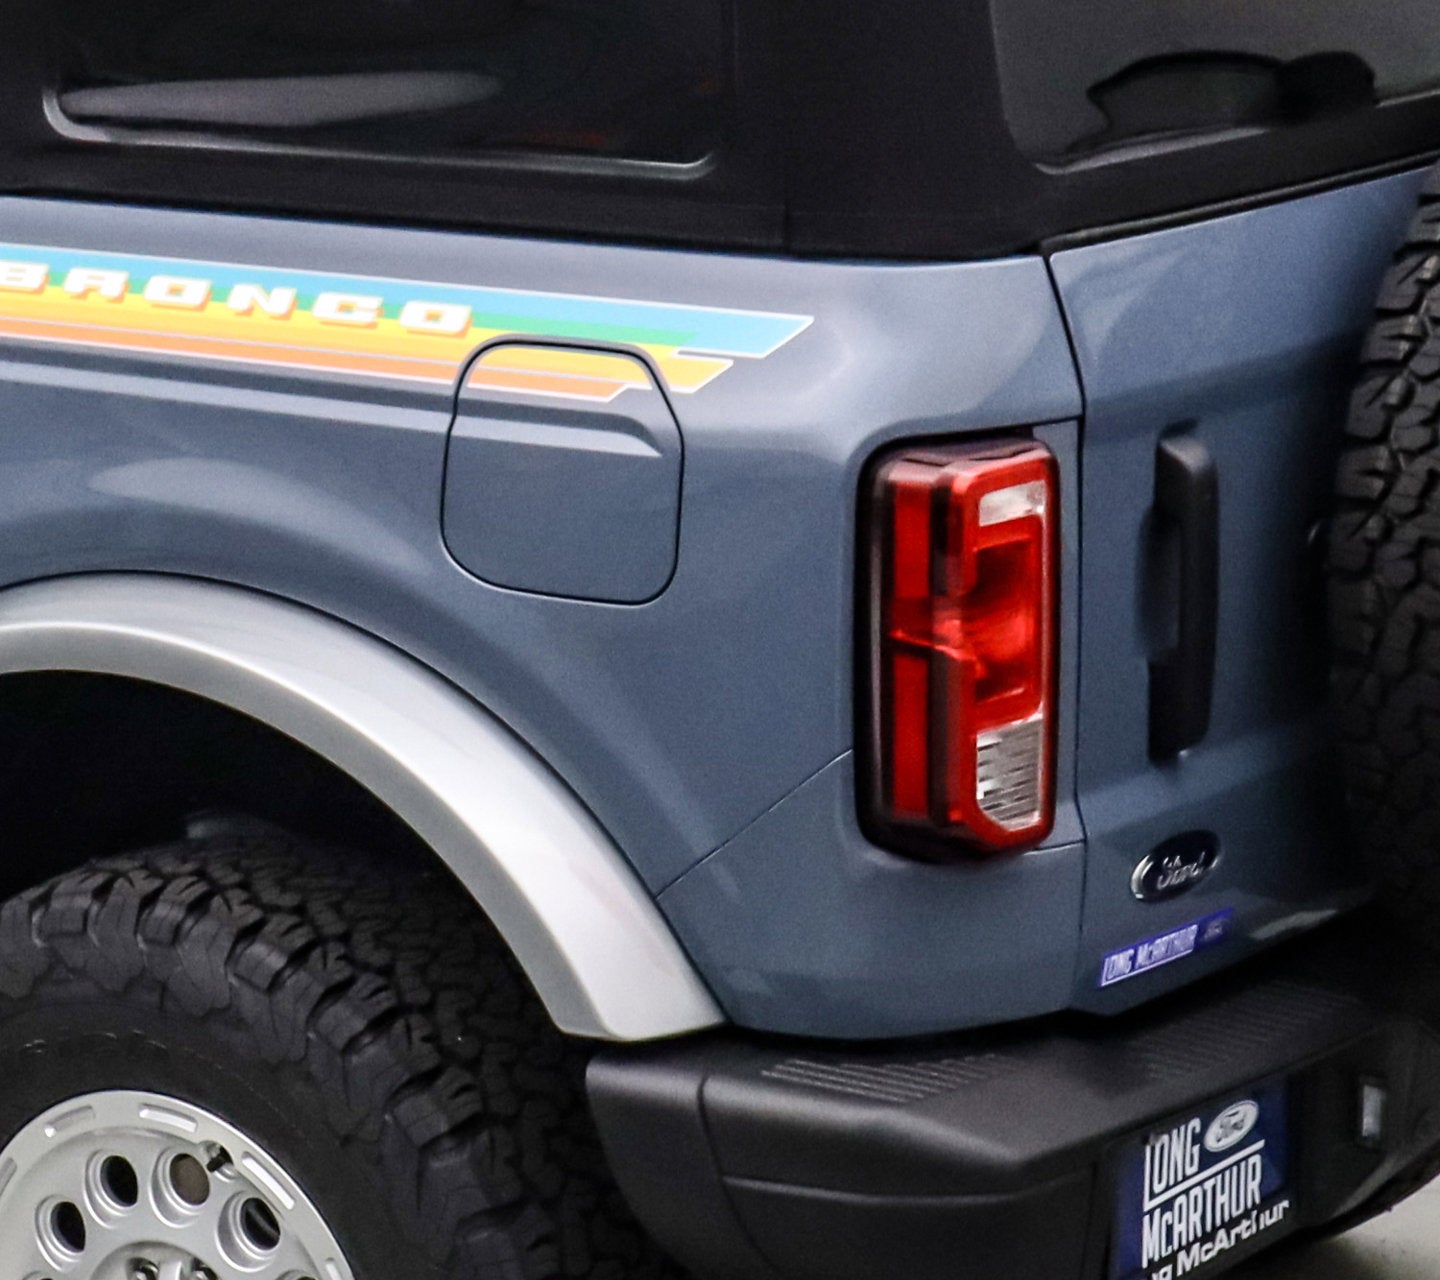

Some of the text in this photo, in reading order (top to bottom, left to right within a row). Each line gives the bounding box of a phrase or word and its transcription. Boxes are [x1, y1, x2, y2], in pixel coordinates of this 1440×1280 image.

[1102, 948, 1134, 985] LONG
[1141, 1153, 1263, 1269] McARTHUR
[1144, 1117, 1201, 1211] LONG
